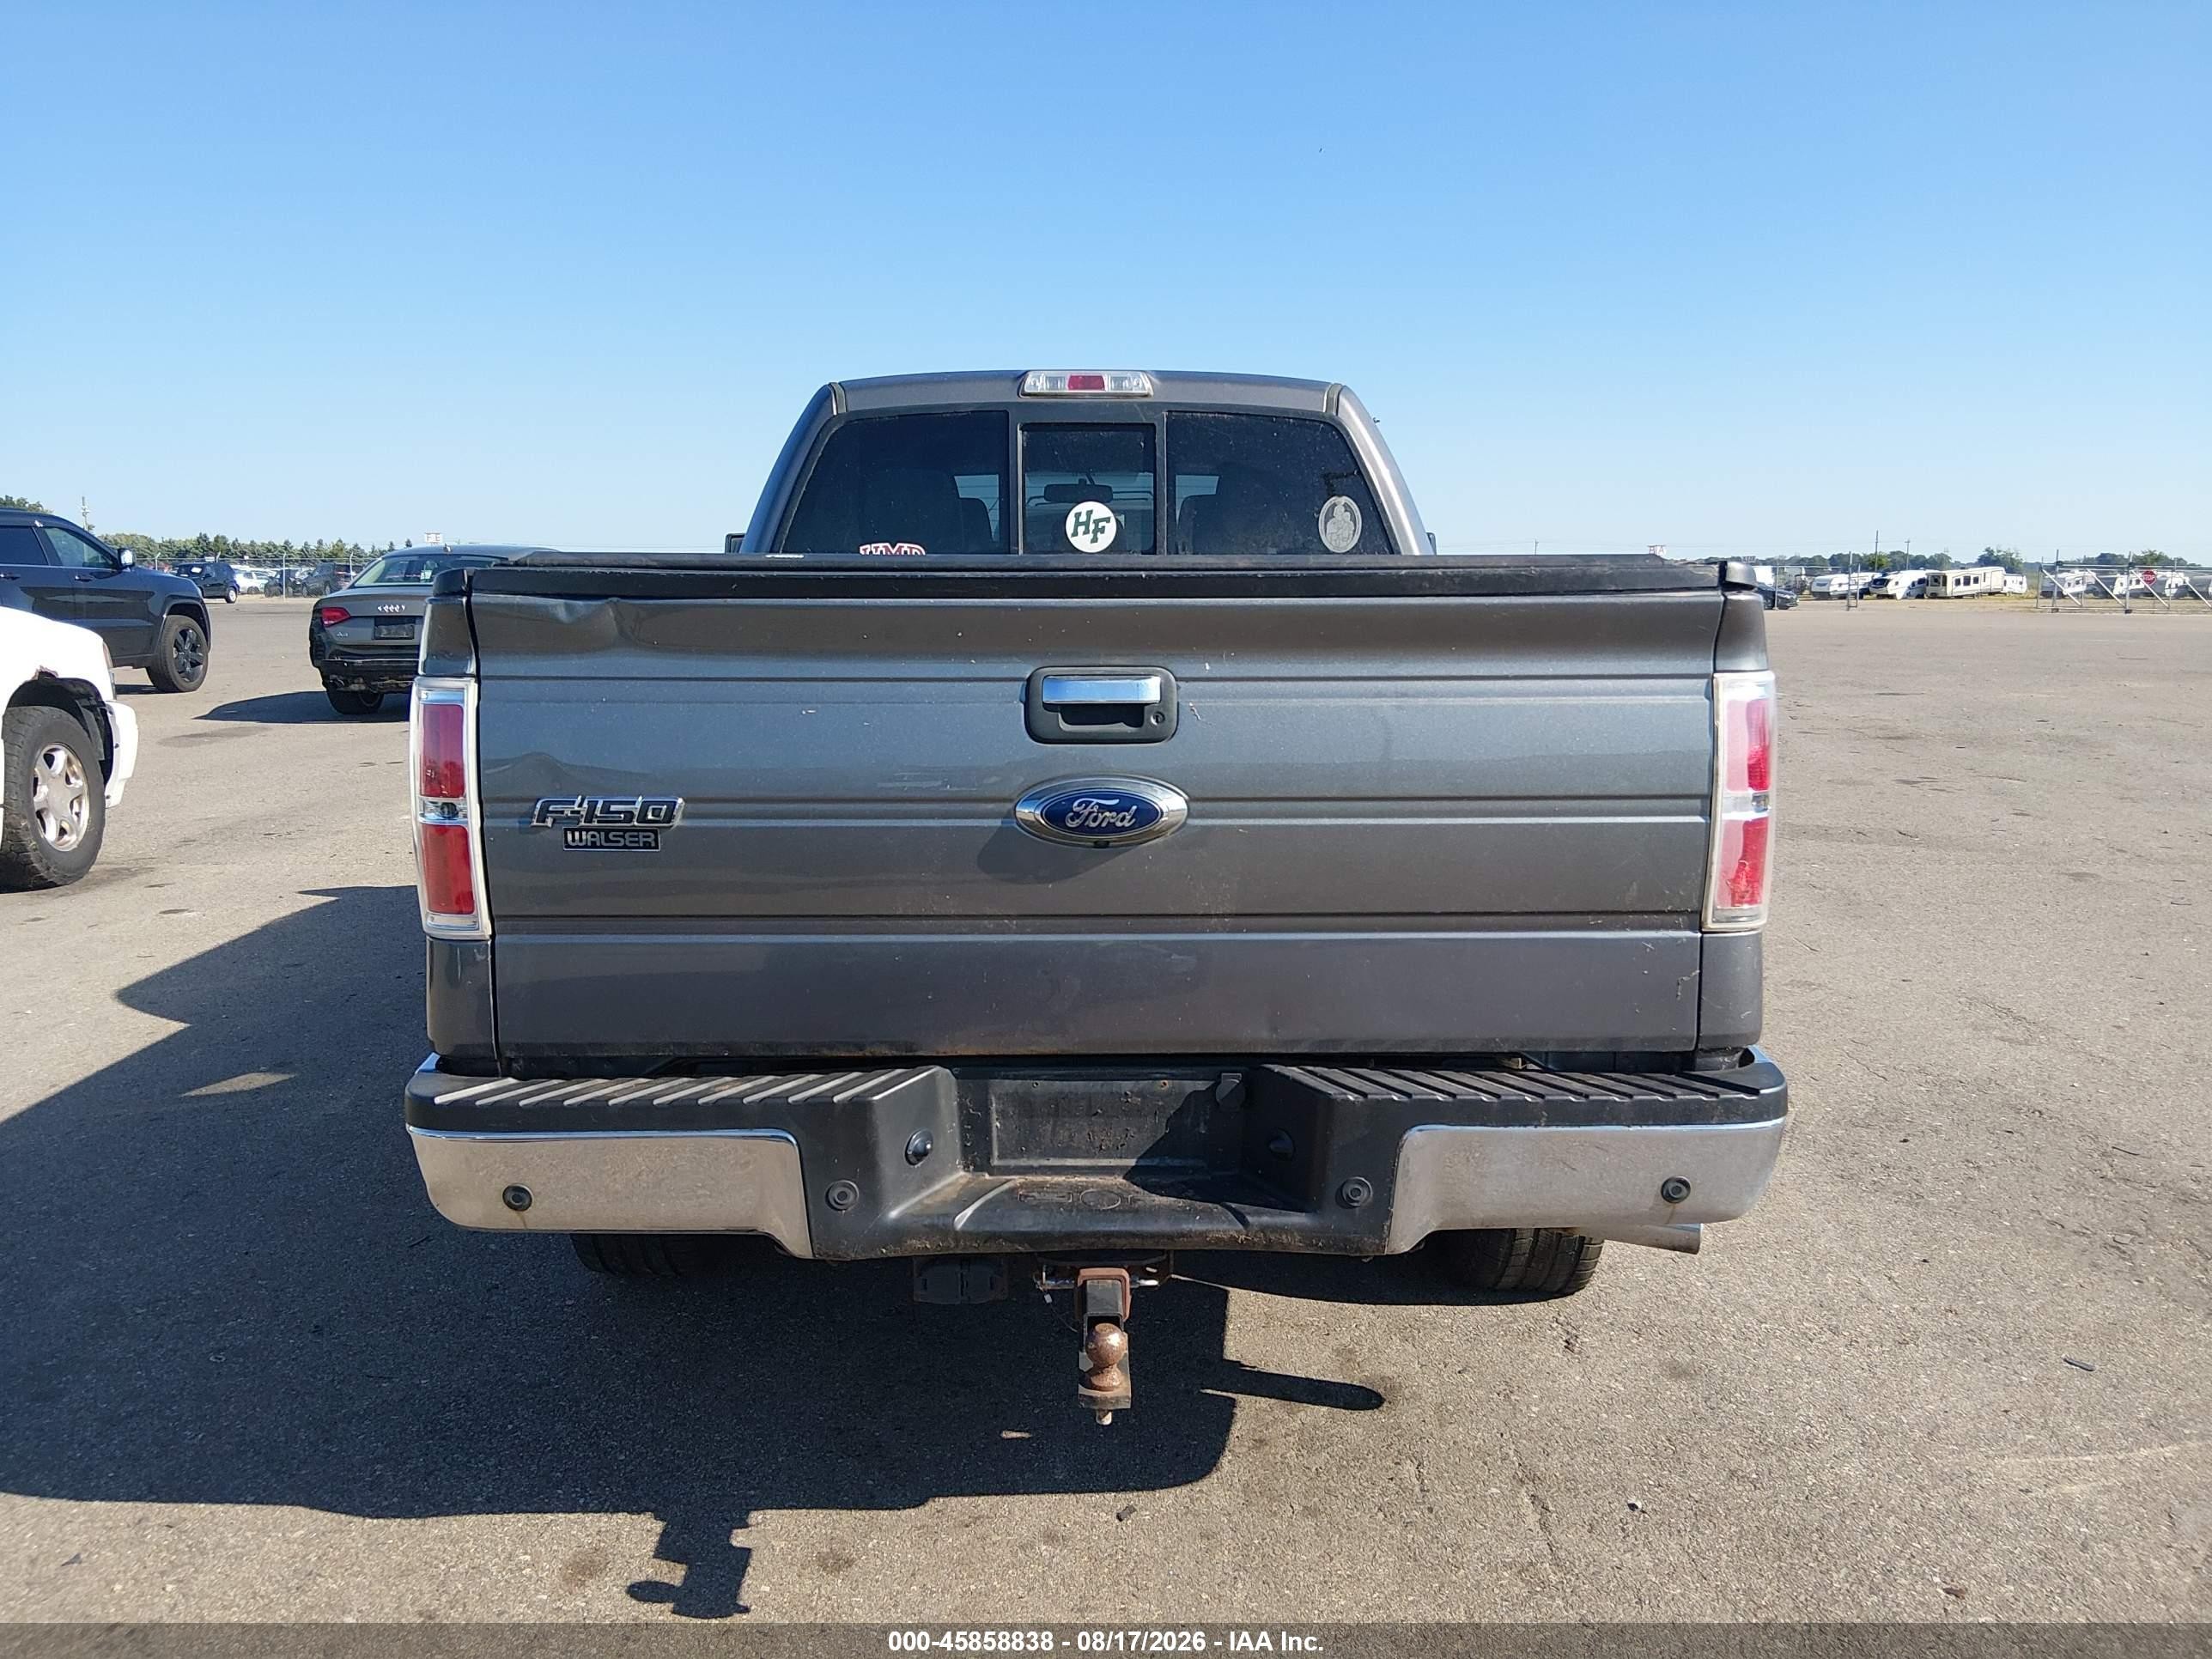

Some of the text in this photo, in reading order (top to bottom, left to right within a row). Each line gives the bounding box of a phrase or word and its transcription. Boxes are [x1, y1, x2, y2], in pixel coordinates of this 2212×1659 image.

[1070, 508, 1111, 544] HF
[530, 795, 684, 828] F-150
[1065, 797, 1137, 828] Ford
[566, 830, 656, 848] WALSER
